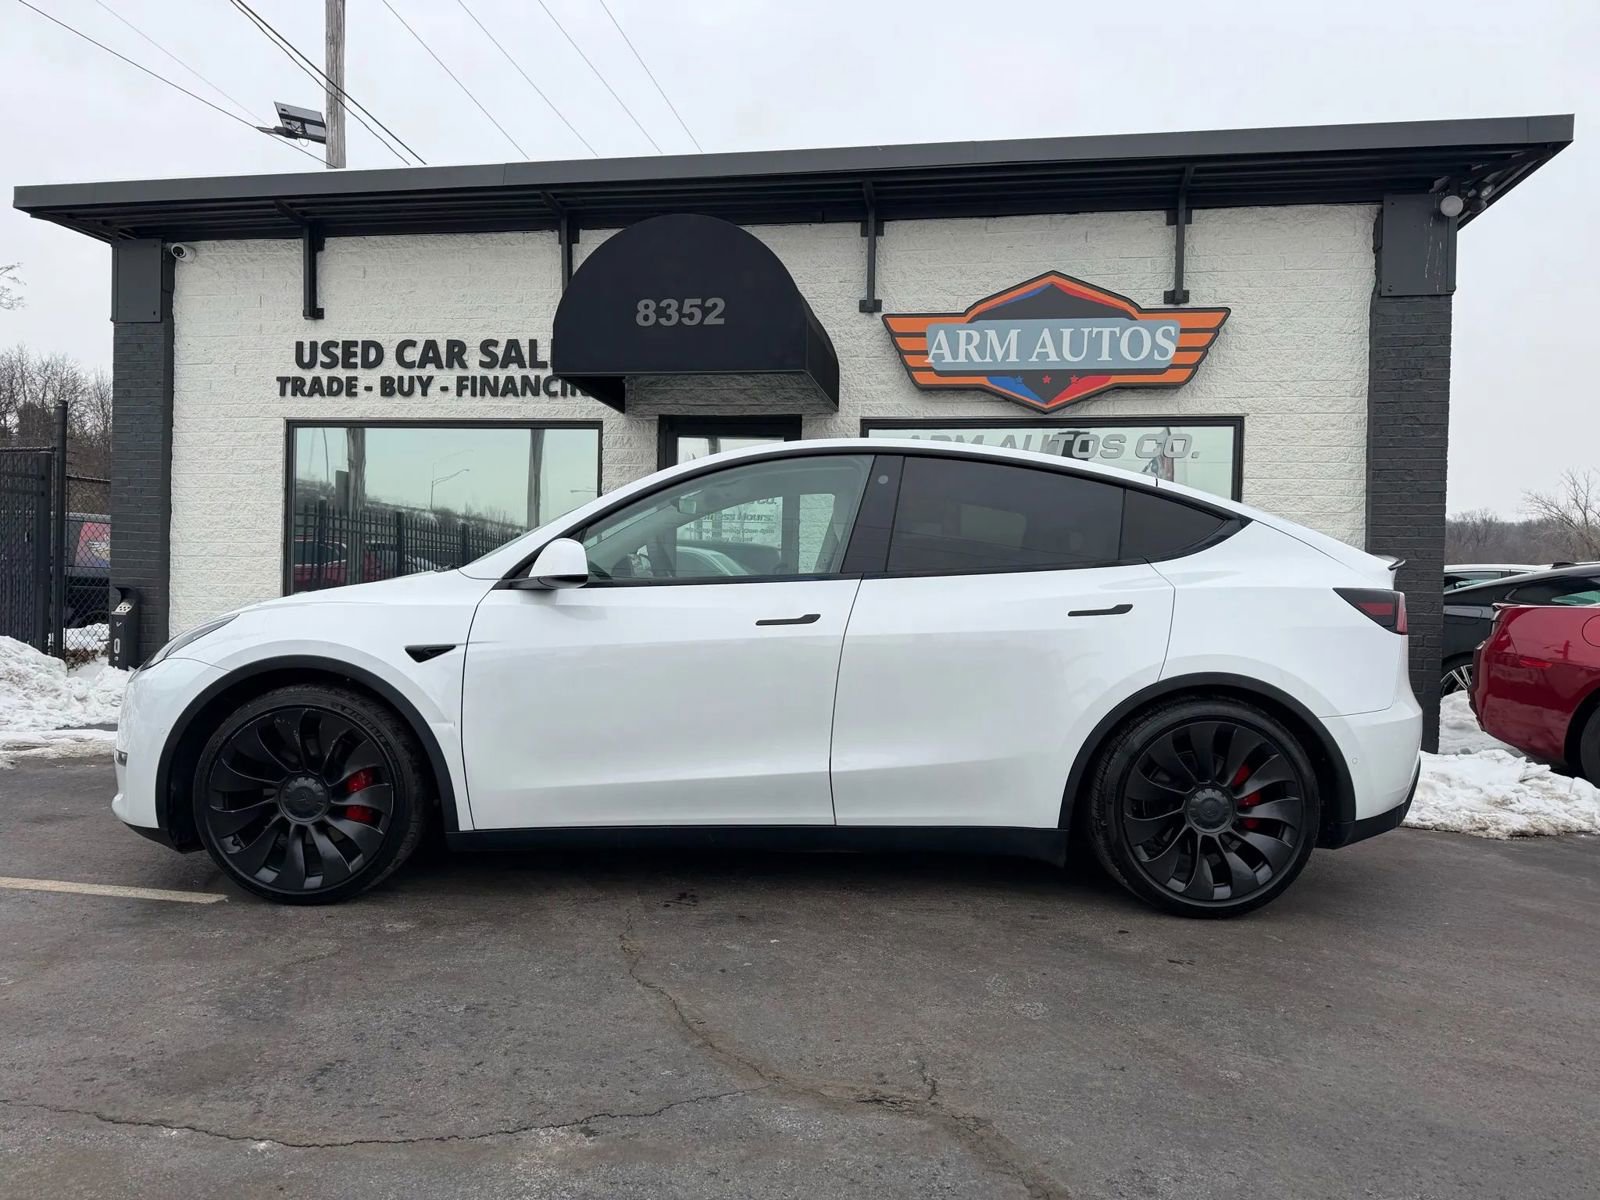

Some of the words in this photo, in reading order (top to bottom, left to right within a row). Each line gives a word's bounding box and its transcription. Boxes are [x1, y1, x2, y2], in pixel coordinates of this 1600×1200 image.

[636, 297, 725, 326] 8352
[295, 340, 384, 370] USED
[395, 339, 469, 369] CAR
[478, 338, 554, 369] SAL
[924, 328, 1021, 363] ARM
[1029, 326, 1177, 362] AUTOS
[276, 376, 358, 397] TRADE
[380, 375, 434, 397] BUY
[1135, 433, 1200, 459] CO.
